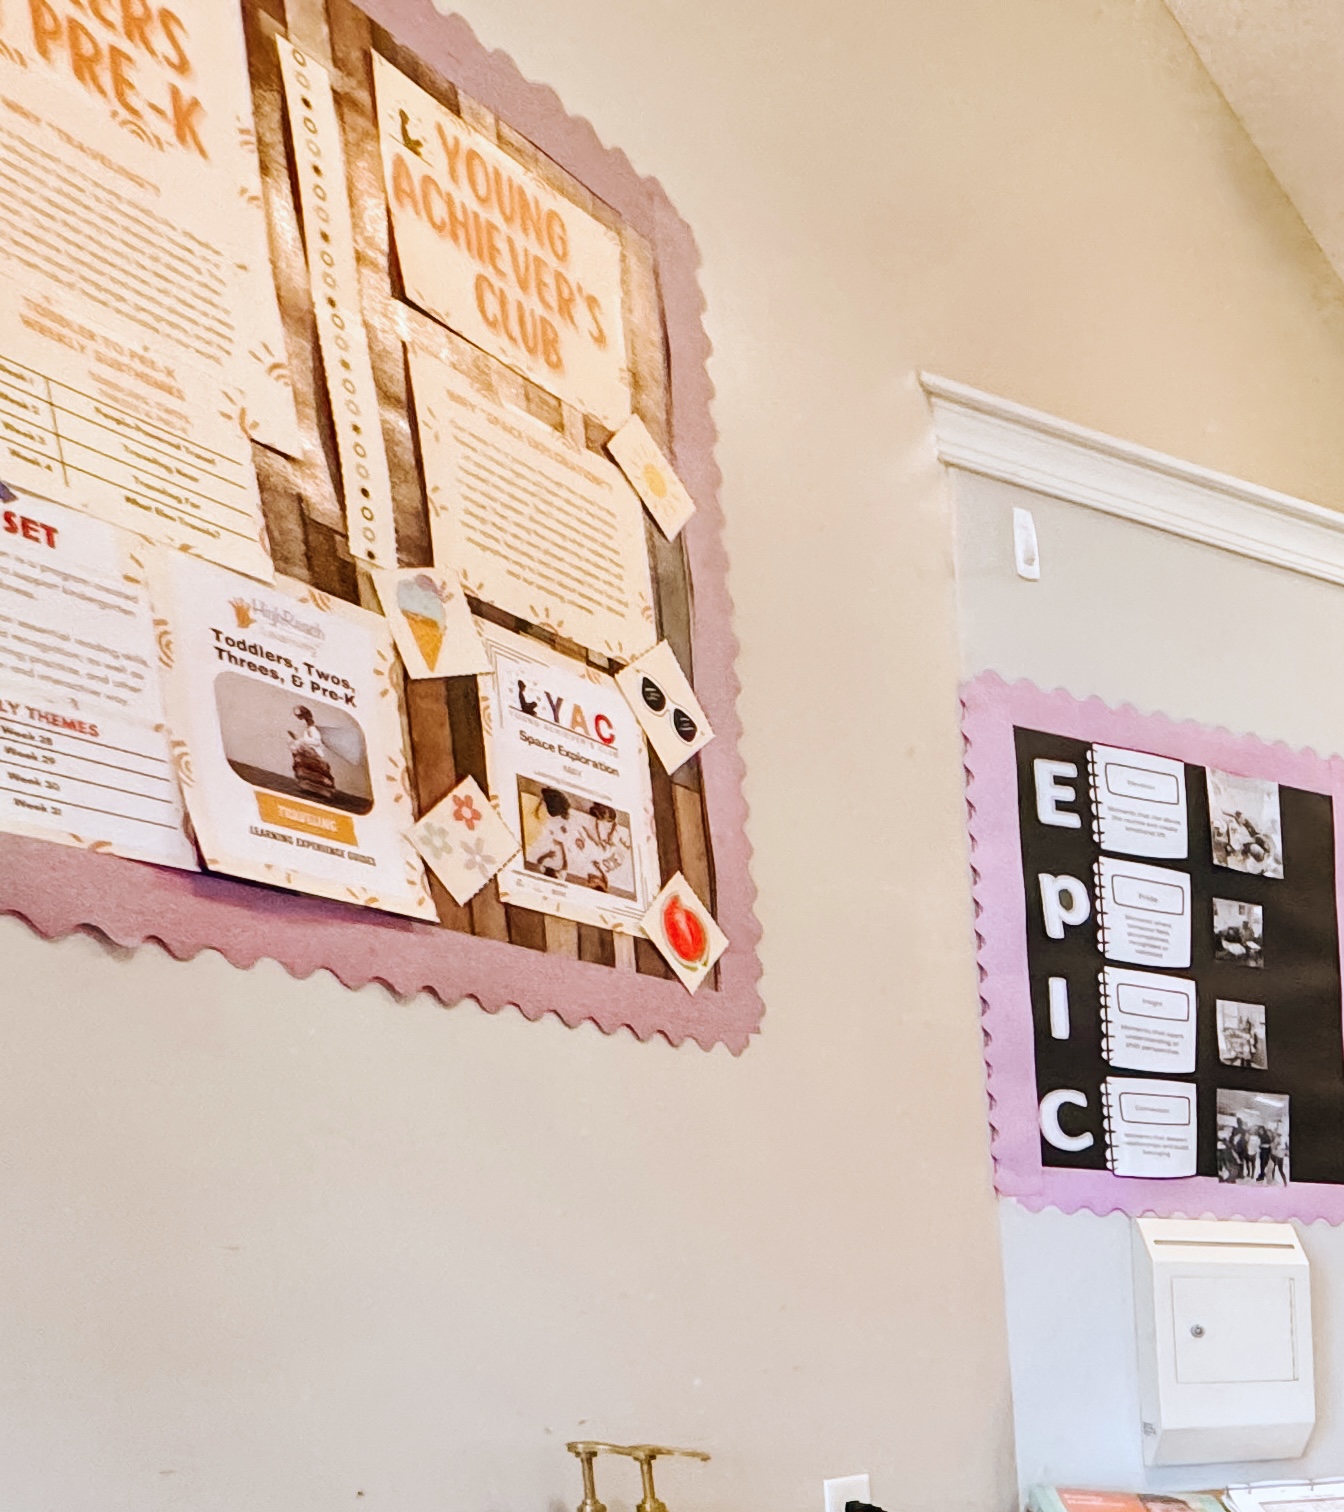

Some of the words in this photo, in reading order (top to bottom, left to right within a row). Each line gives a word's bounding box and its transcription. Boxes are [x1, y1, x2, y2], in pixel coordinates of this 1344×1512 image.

[435, 121, 570, 264] YOUNG
[391, 152, 607, 349] ACHIEVER'S
[474, 272, 563, 373] CLUB
[3, 509, 59, 549] SET
[208, 627, 299, 673] Toddlers,
[302, 661, 356, 694] Twos,
[213, 645, 285, 684] Threes,
[291, 674, 304, 688] &
[310, 680, 358, 709] Pre-K
[25, 705, 100, 738] THEMES
[518, 729, 556, 753] Space
[557, 744, 620, 778] Exploration
